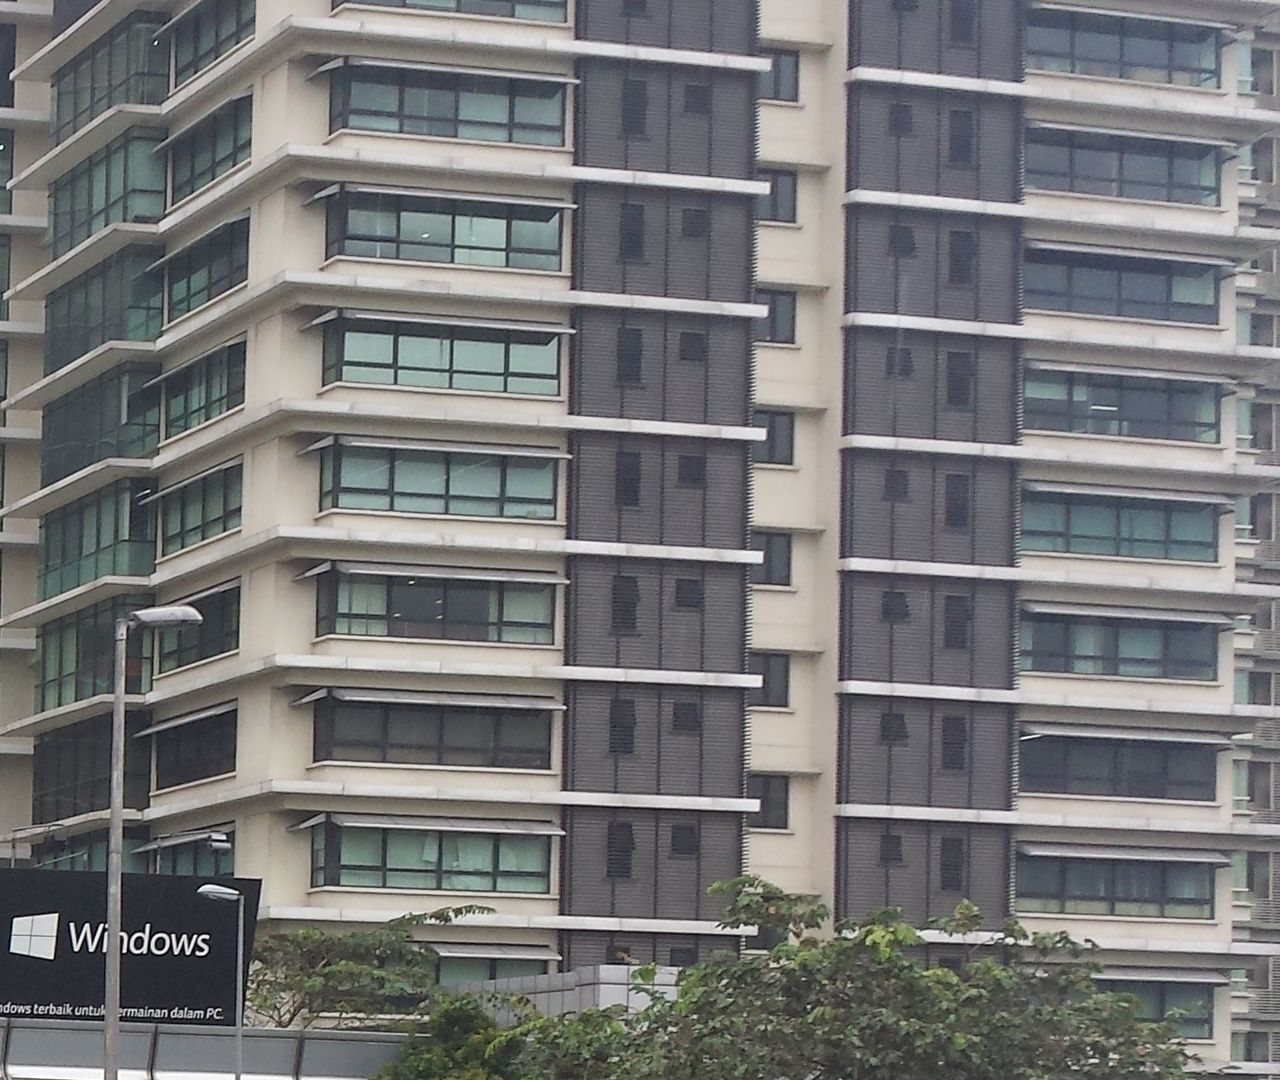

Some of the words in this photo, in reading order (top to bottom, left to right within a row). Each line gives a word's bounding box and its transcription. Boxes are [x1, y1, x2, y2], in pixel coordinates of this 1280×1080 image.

[69, 921, 210, 956] Windows
[33, 1002, 73, 1015] terbaik
[75, 1003, 106, 1016] untuk
[118, 1005, 168, 1018] ermainan
[170, 1006, 204, 1019] dalam
